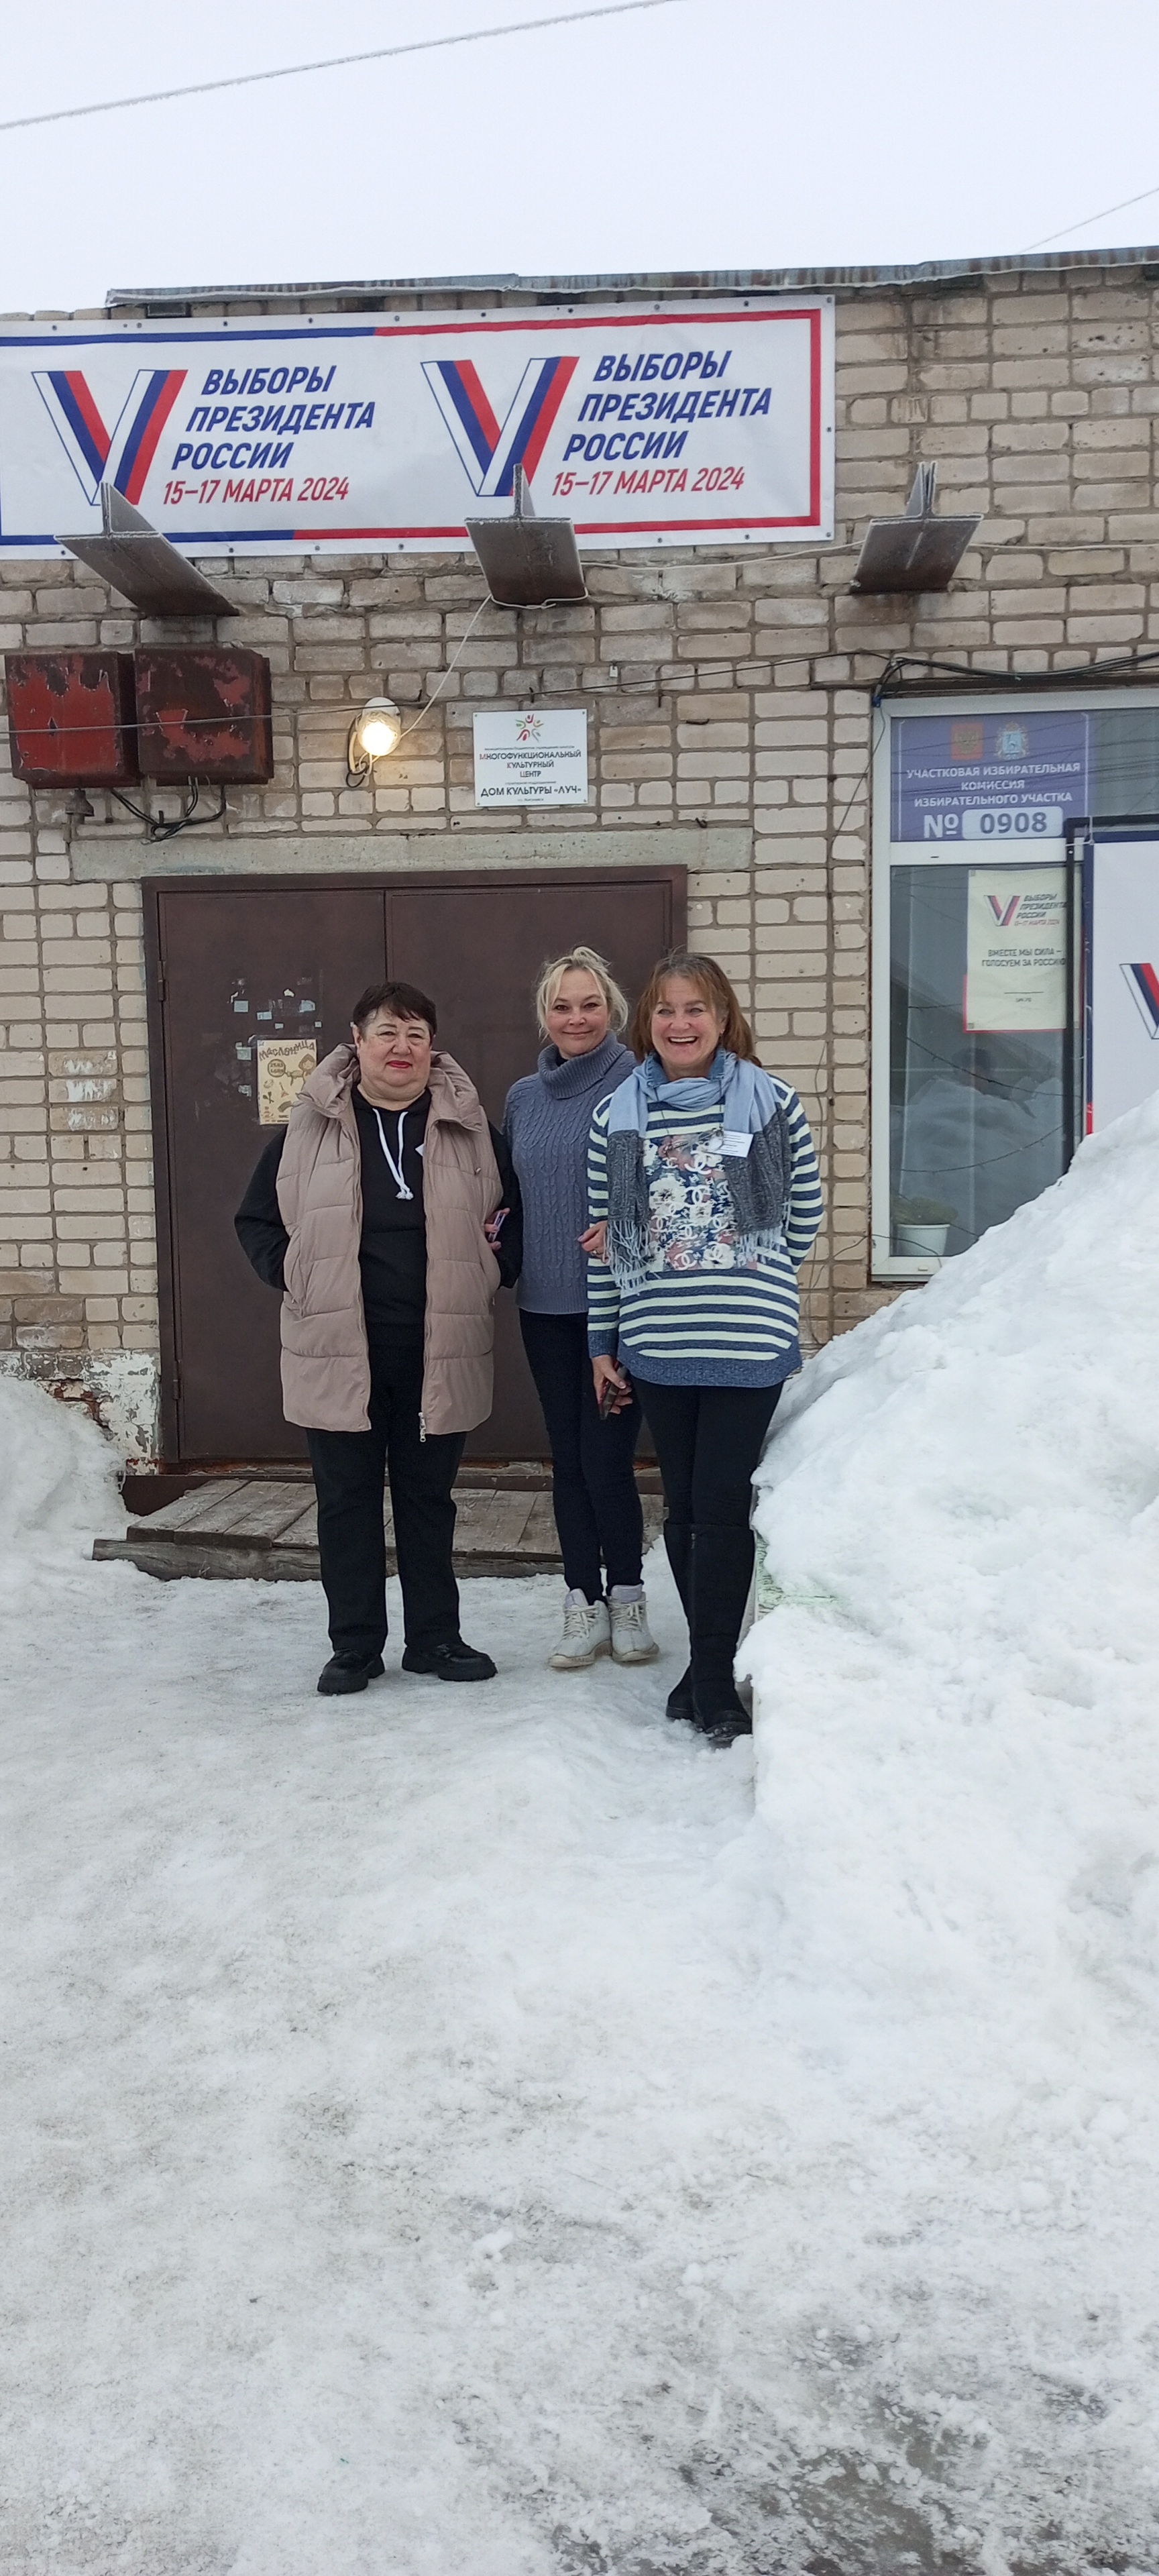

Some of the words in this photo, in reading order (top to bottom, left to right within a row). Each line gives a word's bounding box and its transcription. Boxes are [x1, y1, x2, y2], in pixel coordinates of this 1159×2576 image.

[592, 350, 733, 383] ВЫБОРЫ
[201, 365, 337, 396] ВЫБОРЫ
[577, 387, 773, 424] ПРЕЗИДЕНТА
[185, 401, 376, 436] ПРЕЗИДЕНТА
[171, 441, 294, 471] РОССИИ
[563, 430, 689, 462] РОССИИ
[222, 477, 294, 504] МАРТА
[297, 477, 349, 502] 2024
[613, 468, 689, 495] МАРТА
[691, 466, 745, 492] 2024
[480, 749, 582, 760] МНОГОФУНКЦИОНАЛЬНЫЙ
[506, 759, 554, 769] КУЛЬТУРНЫЙ
[907, 767, 980, 779] УЧАСТКОВАЯ
[983, 763, 1081, 776] ИЗБИРАТЕЛЬНАЯ
[480, 787, 504, 798] ДОМ
[506, 786, 552, 796] КУЛЬТУРЫ
[960, 780, 1026, 791] КОМИССИЯ
[914, 794, 1019, 807] ИЗБИРАТЕЛЬНОГО
[1020, 792, 1073, 803] УЧАСТКА
[924, 813, 960, 839] №
[979, 812, 1048, 834] 0908
[1024, 894, 1058, 902] ВЫБОРЫ
[1016, 911, 1046, 919] РОССИИ
[988, 949, 1017, 957] ВМЕСТЕ
